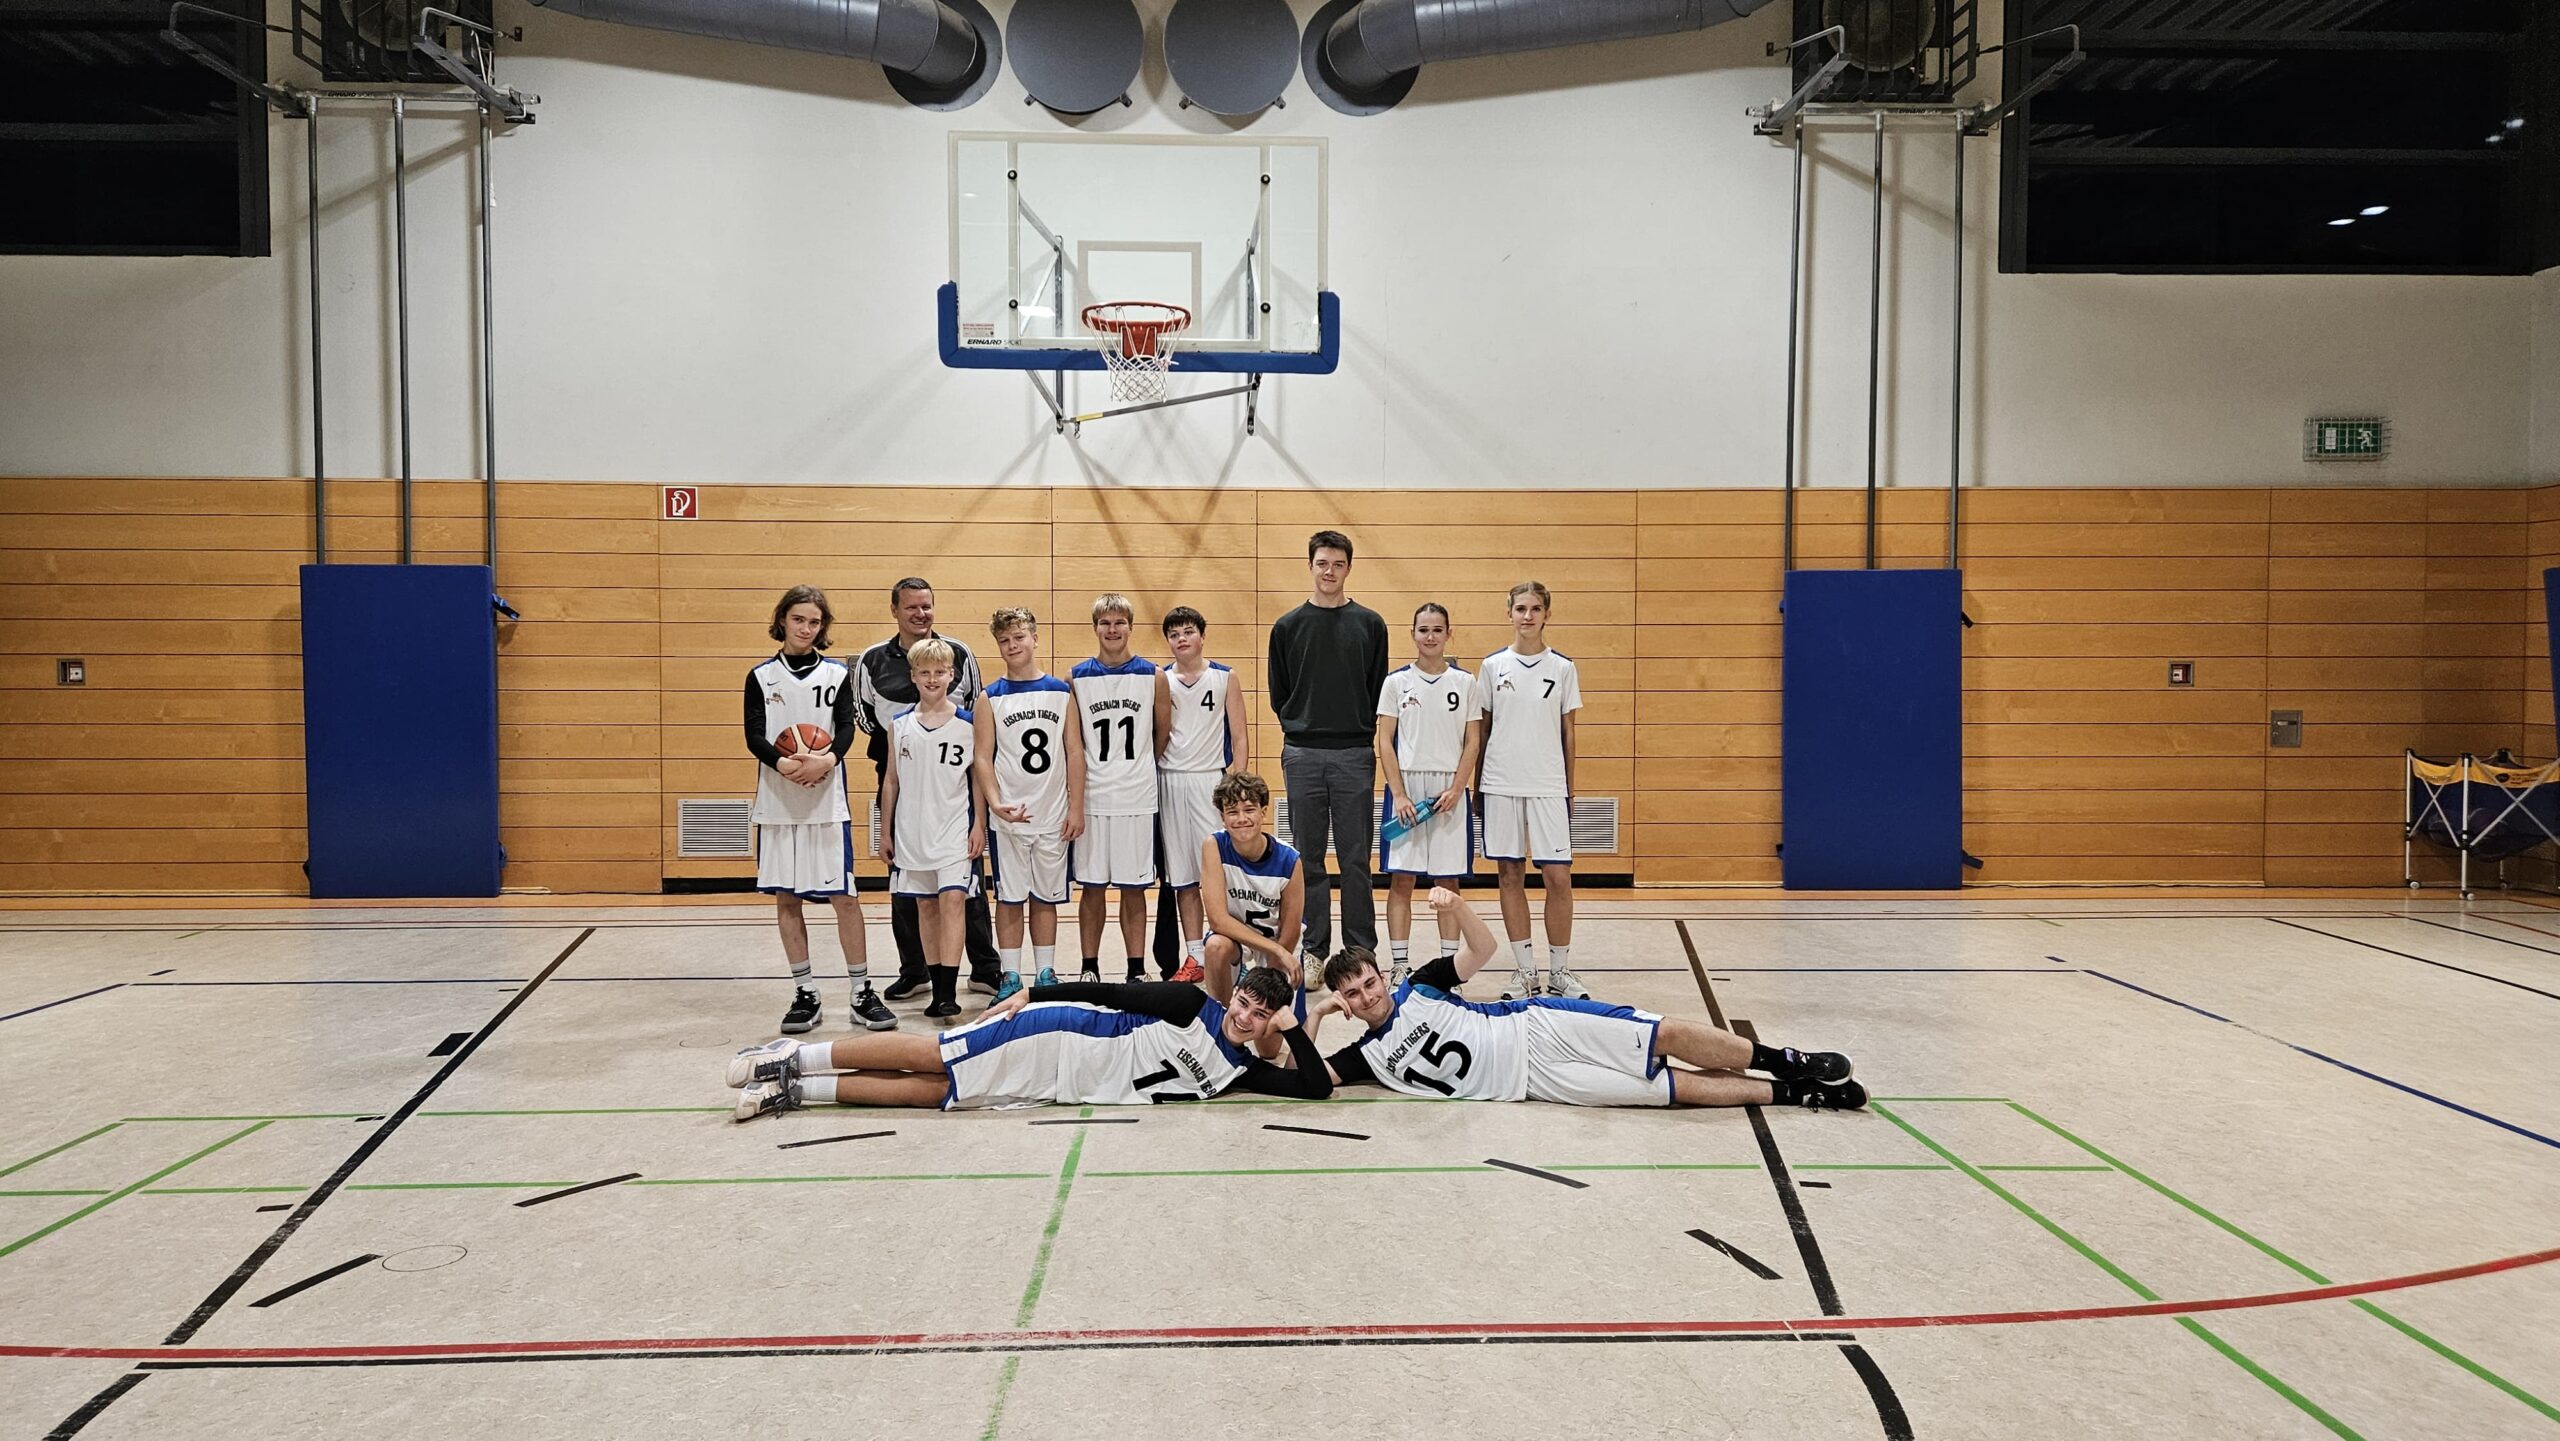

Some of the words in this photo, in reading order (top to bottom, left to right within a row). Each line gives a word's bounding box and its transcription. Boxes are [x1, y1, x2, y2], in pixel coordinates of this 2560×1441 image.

[812, 685, 836, 708] 10
[1543, 678, 1555, 699] 7
[1122, 698, 1141, 712] TGERS
[1200, 690, 1215, 712] 4
[1447, 691, 1460, 712] 9
[1003, 709, 1036, 728] EISENACH
[1092, 716, 1135, 761] 11
[938, 742, 965, 766] 13
[1021, 728, 1051, 775] 8
[1258, 893, 1280, 908] TIGER
[1245, 909, 1275, 938] 5
[1403, 1021, 1430, 1048] TIGERS
[1176, 1047, 1208, 1084] EISENACH
[1403, 1030, 1472, 1097] 15
